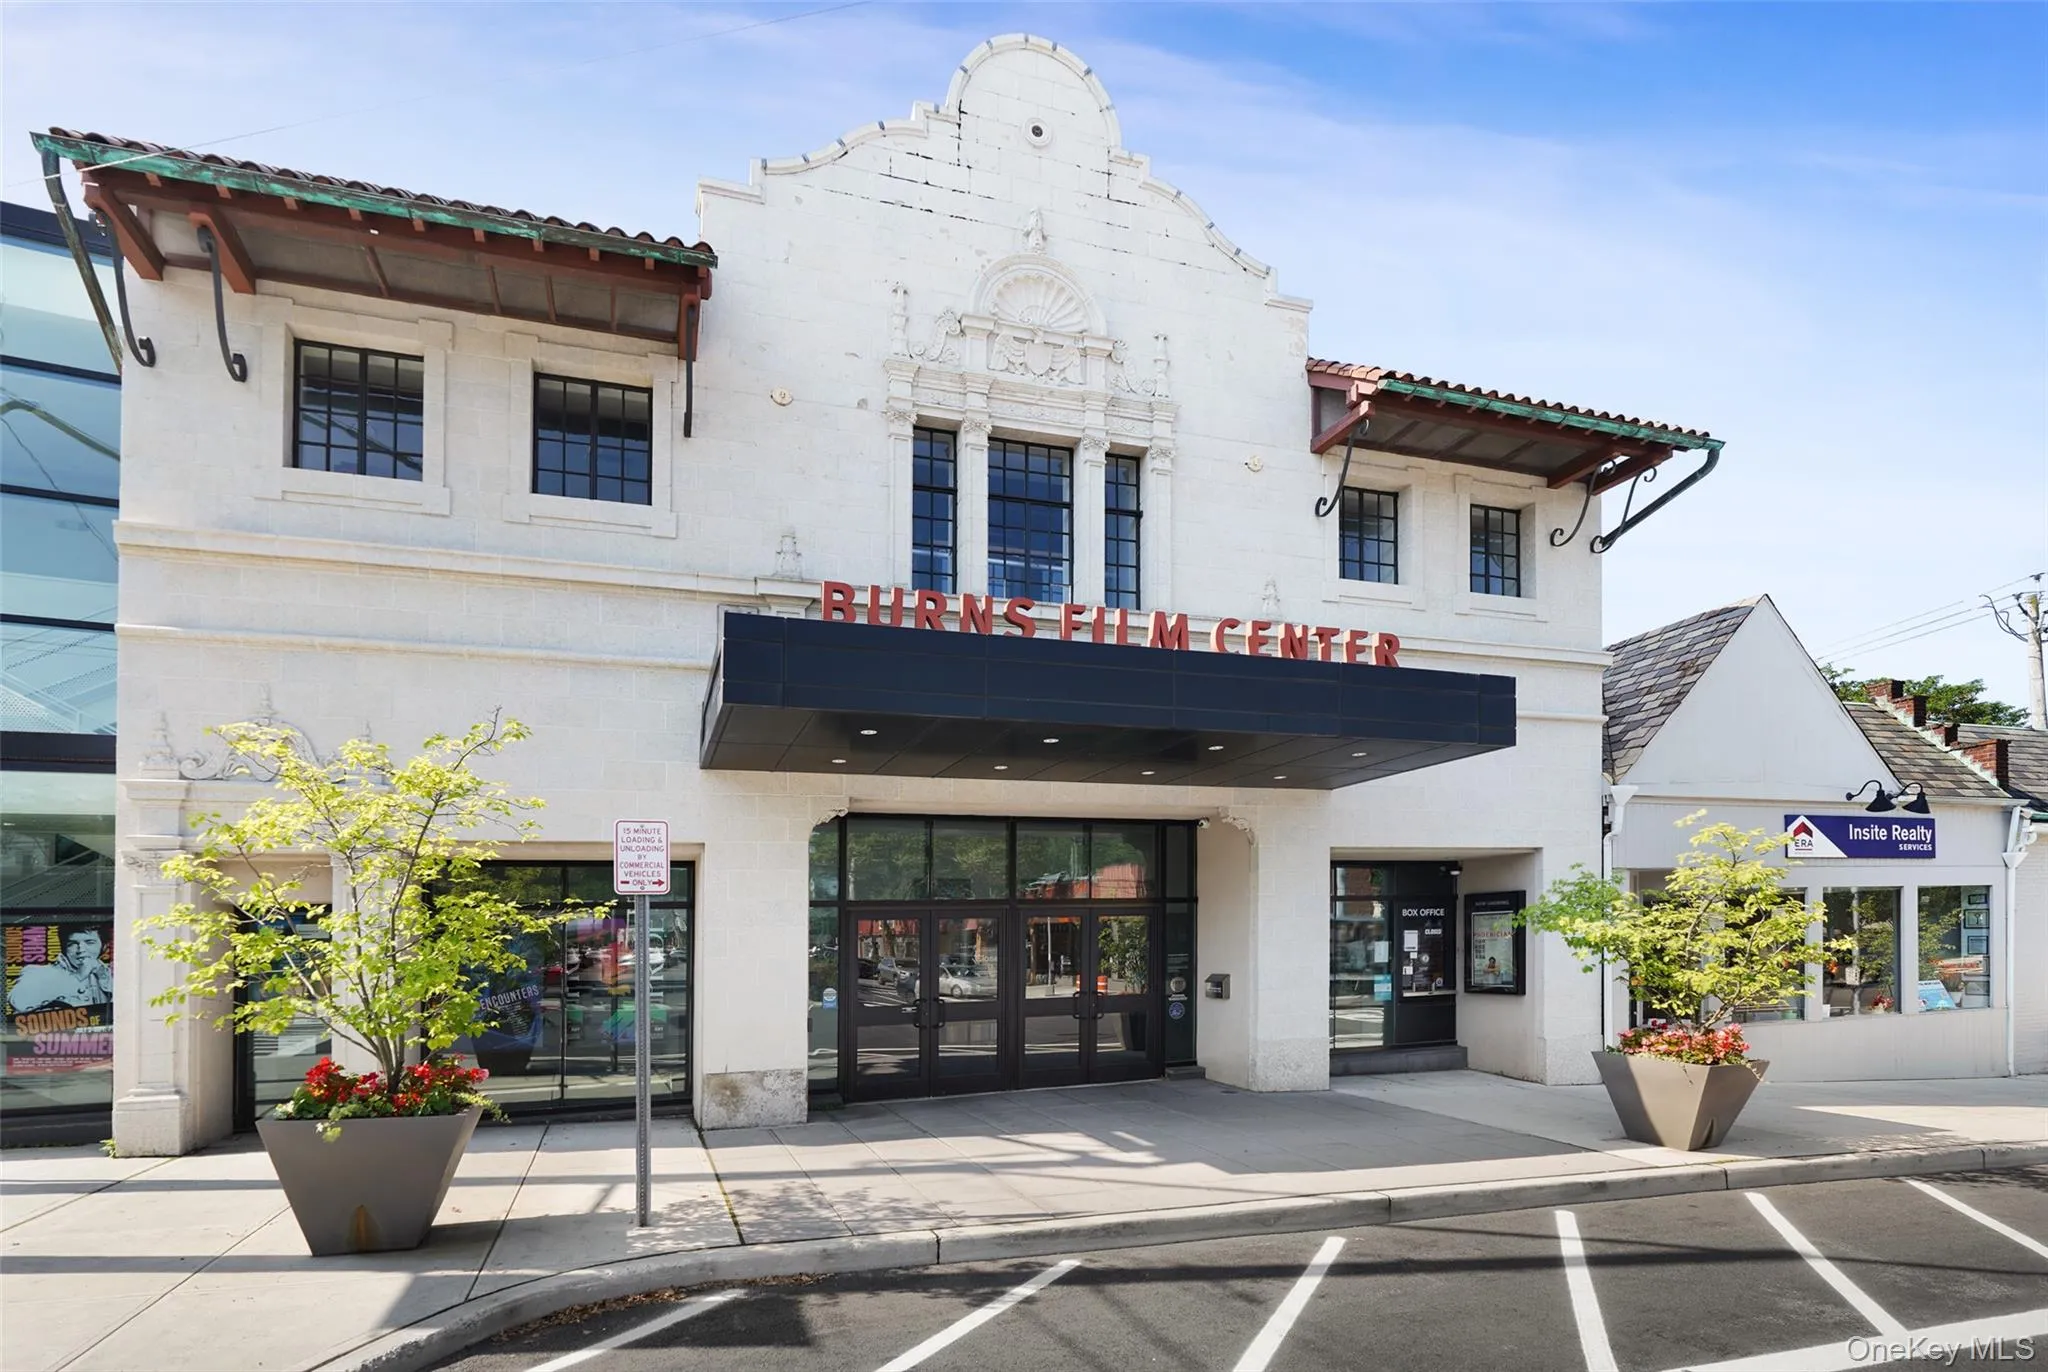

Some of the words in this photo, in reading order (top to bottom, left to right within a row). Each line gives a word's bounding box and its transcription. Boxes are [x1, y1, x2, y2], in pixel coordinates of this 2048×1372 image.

[820, 581, 1038, 638] BURNS
[1060, 603, 1189, 651] FILM
[1210, 617, 1401, 667] CENTER
[1794, 839, 1813, 847] ERA
[1848, 823, 1888, 840] Insite
[1891, 824, 1932, 843] Realty
[1898, 843, 1932, 851] SERVICES
[1402, 908, 1418, 916] BOX
[1420, 908, 1445, 916] OFFICE
[480, 985, 540, 1010] ENCOUNTERS
[15, 1007, 89, 1037] SOUNDS
[90, 1015, 100, 1025] OF
[33, 1032, 113, 1055] SUMME
